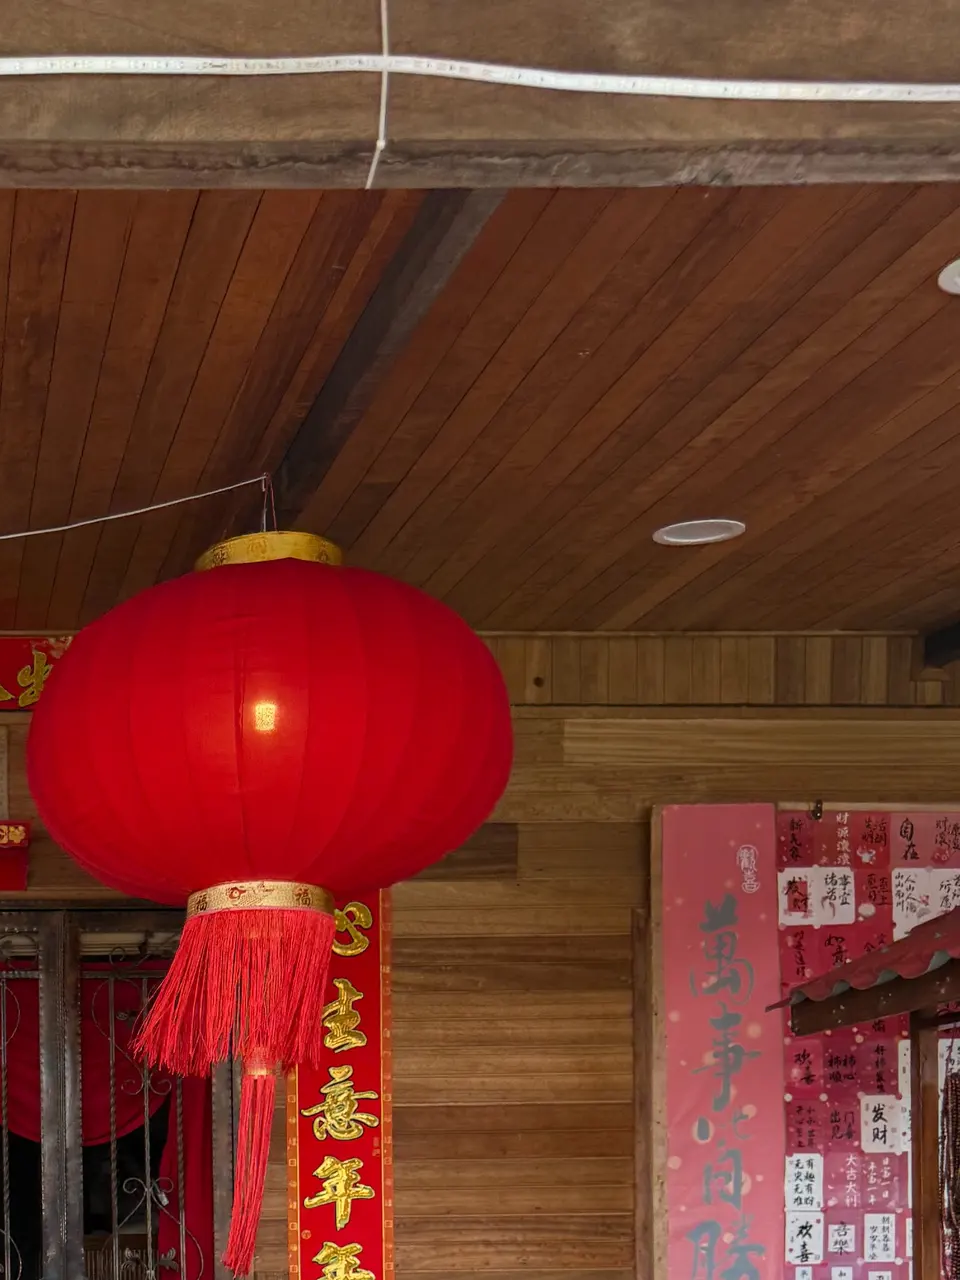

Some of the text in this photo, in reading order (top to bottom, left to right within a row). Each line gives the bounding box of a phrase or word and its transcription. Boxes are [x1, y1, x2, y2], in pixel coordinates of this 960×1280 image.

[872, 1103, 888, 1145] 发财
[845, 1153, 859, 1207] 大吉大利
[795, 1221, 816, 1263] 欢喜
